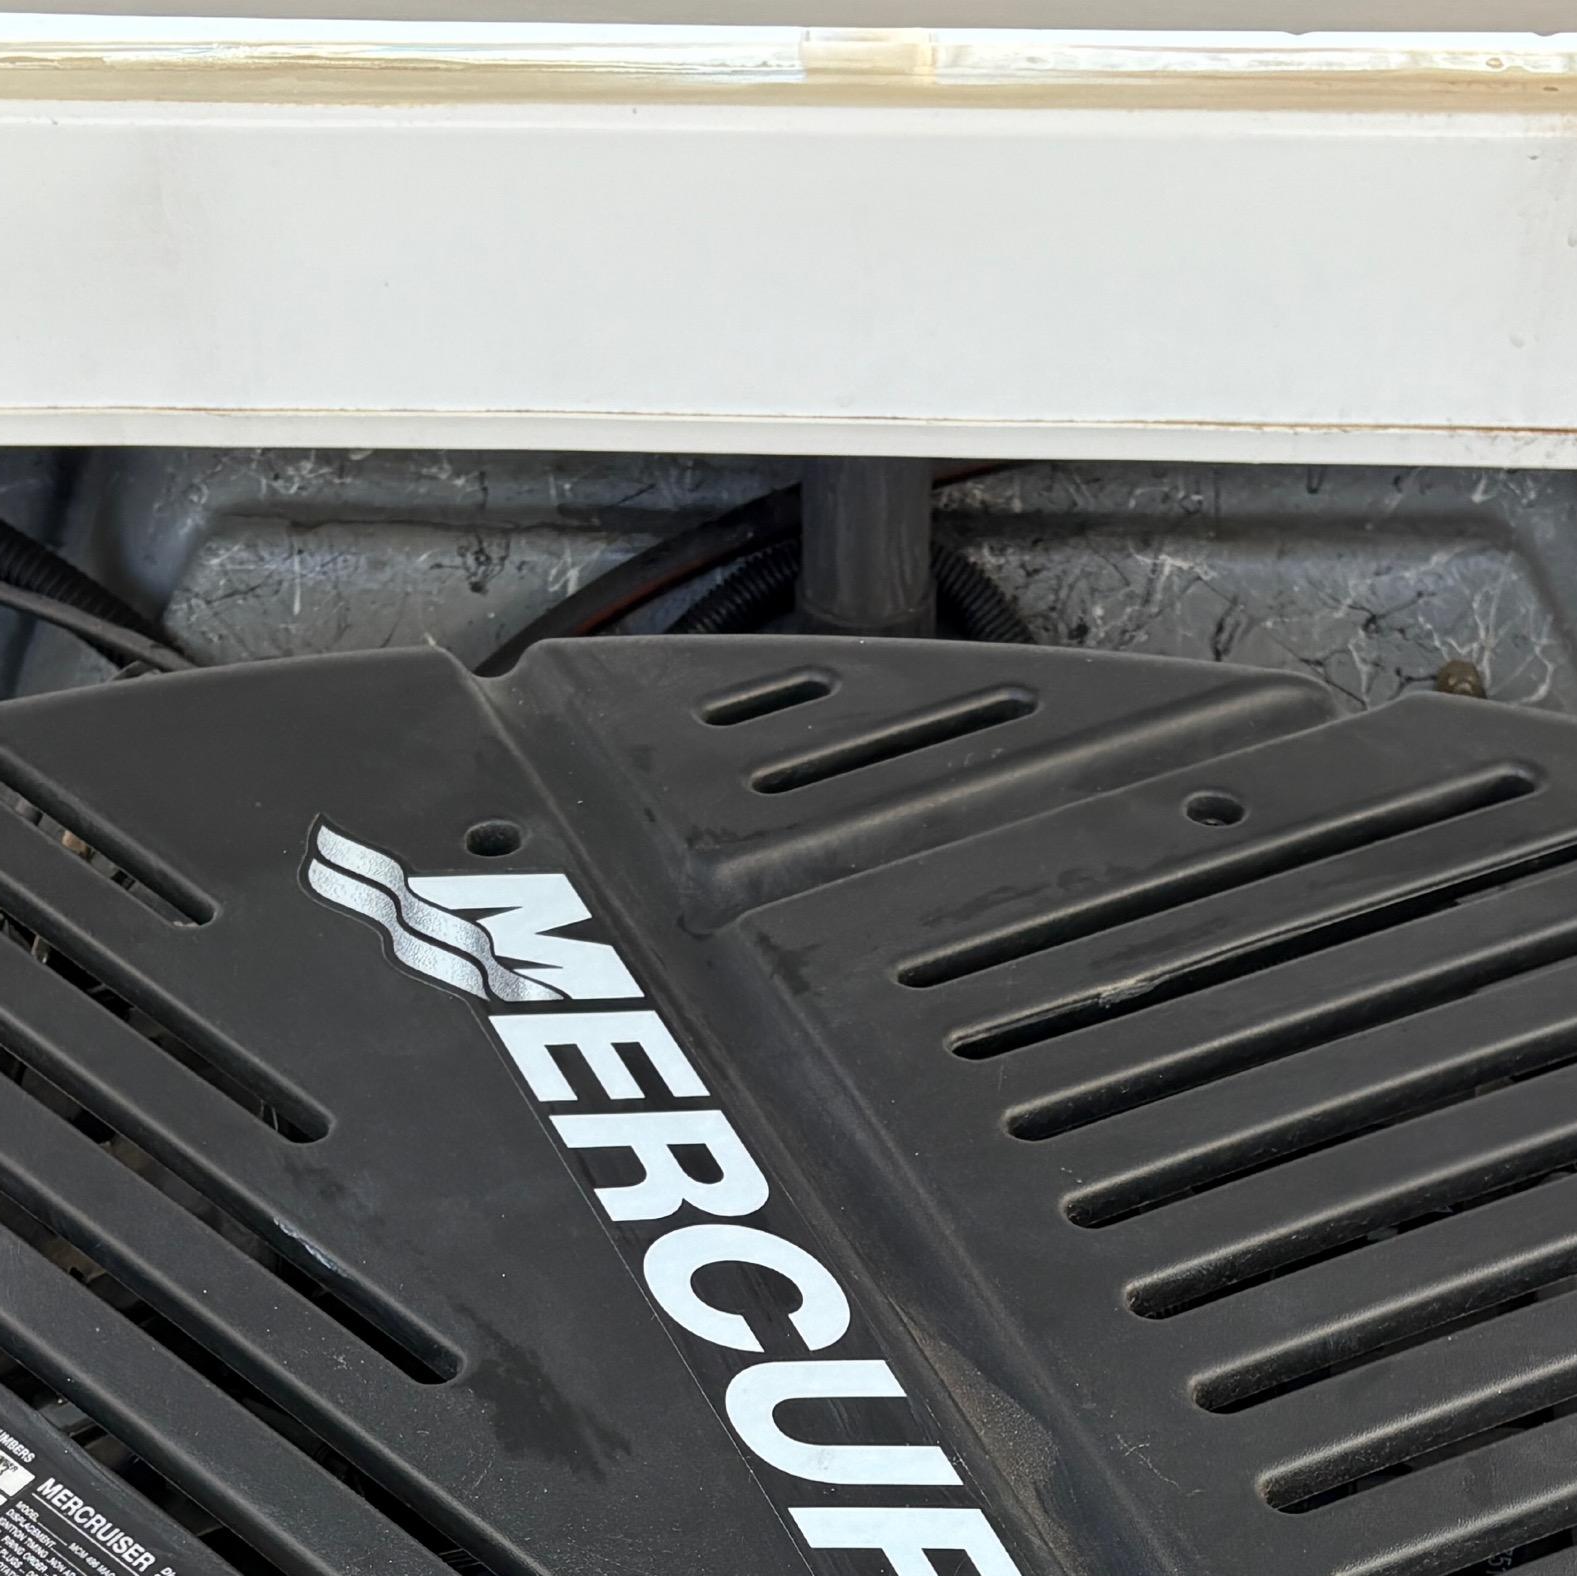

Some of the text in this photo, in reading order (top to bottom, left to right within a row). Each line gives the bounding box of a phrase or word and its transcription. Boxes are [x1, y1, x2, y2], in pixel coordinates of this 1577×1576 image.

[15, 1501, 40, 1519] MODEL
[5, 1509, 55, 1547] DISPLACEMENT
[36, 1476, 155, 1571] MERCRUISER
[23, 1538, 48, 1557] TIMING
[22, 1552, 47, 1572] ORDER
